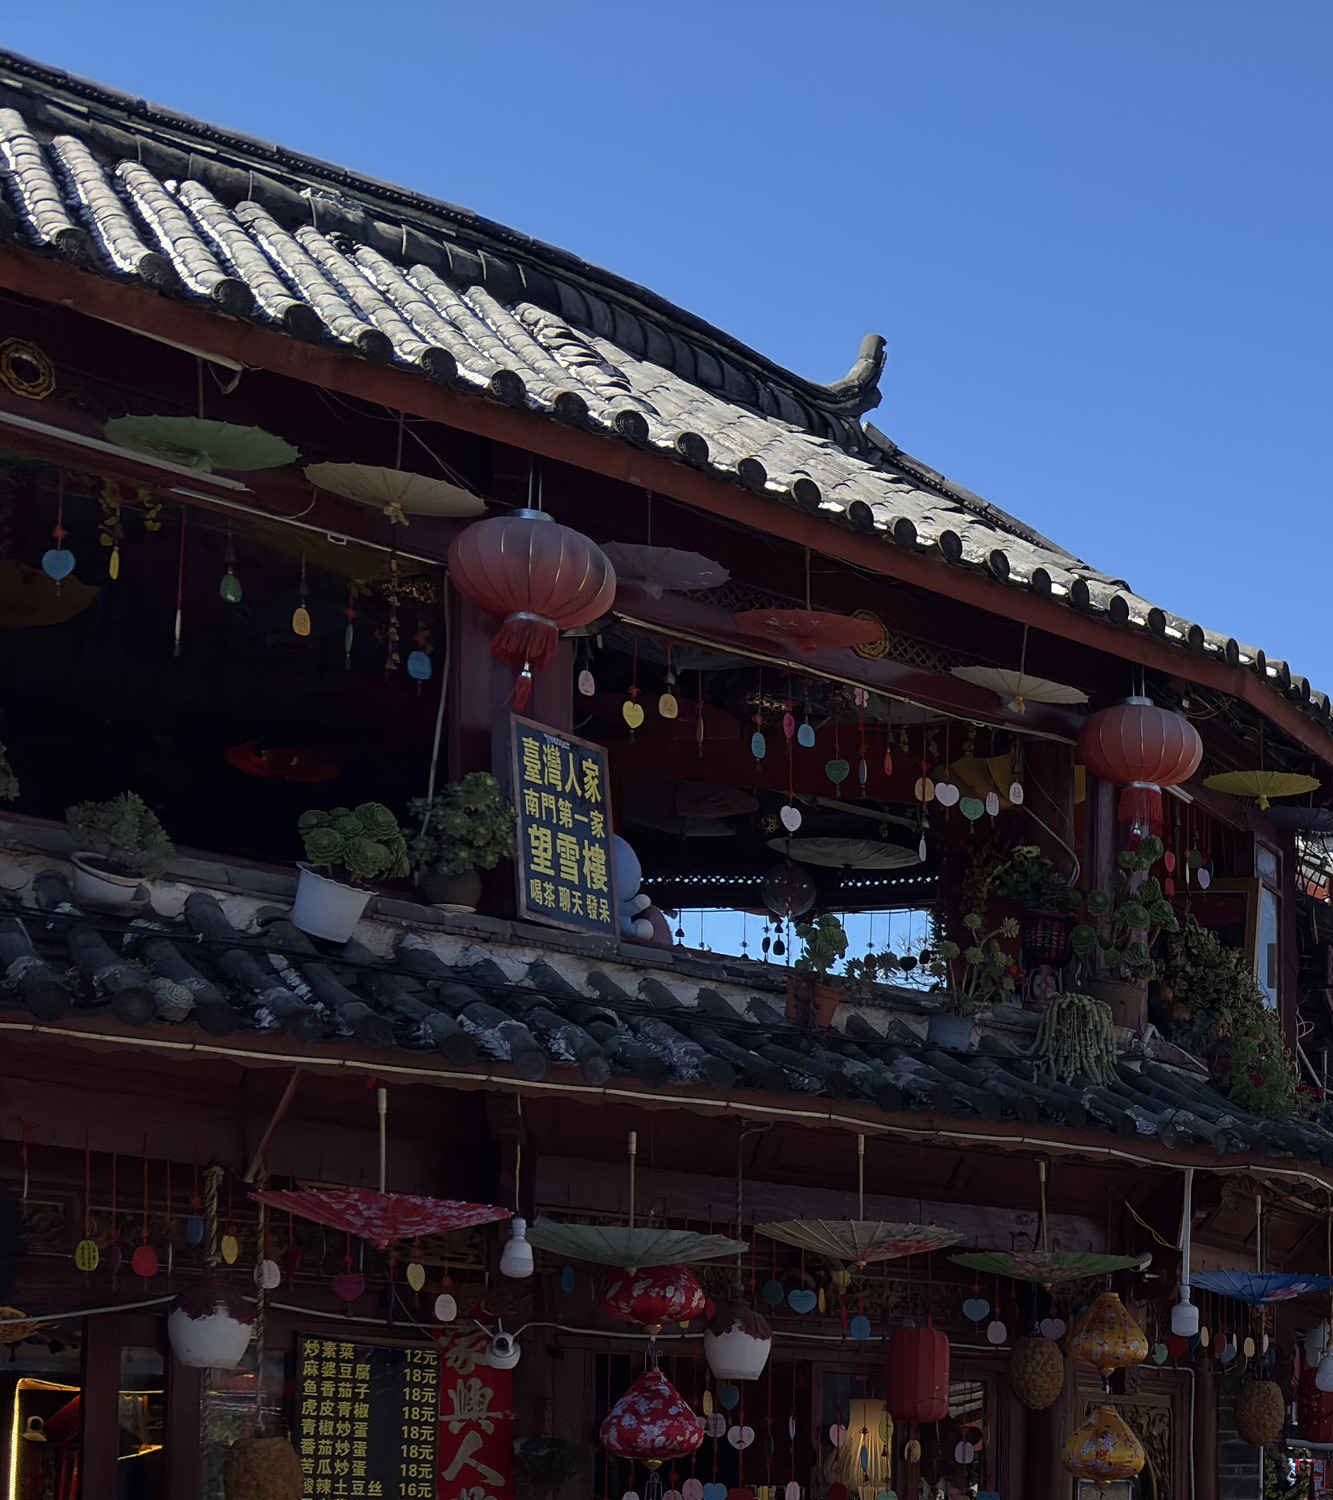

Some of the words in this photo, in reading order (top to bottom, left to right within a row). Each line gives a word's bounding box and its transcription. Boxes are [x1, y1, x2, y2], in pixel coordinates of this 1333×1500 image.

[521, 736, 602, 804] 臺灣人家
[523, 787, 606, 839] 南門第一家
[528, 823, 609, 893] 望雪樓
[529, 878, 556, 909] 喝茶
[558, 885, 584, 916] 聊天
[586, 893, 611, 924] 發呆
[304, 1340, 355, 1359] 炒素菜
[405, 1349, 438, 1365] 12元
[303, 1361, 371, 1380] 麻婆豆腐
[404, 1368, 437, 1384] 18元
[303, 1380, 370, 1399] 鱼香茄子
[403, 1388, 436, 1403] 18元
[302, 1399, 370, 1418] 虎皮青椒
[402, 1407, 435, 1422] 18元
[301, 1419, 368, 1438] 青椒炒蛋
[402, 1426, 434, 1441] 18元
[300, 1438, 367, 1457] 番茄炒蛋
[401, 1445, 434, 1460] 18元
[300, 1458, 366, 1476] 苦瓜炒蛋
[400, 1464, 433, 1479] 18元
[303, 1478, 383, 1496] 酸辣土豆丝
[399, 1483, 432, 1498] 16元
